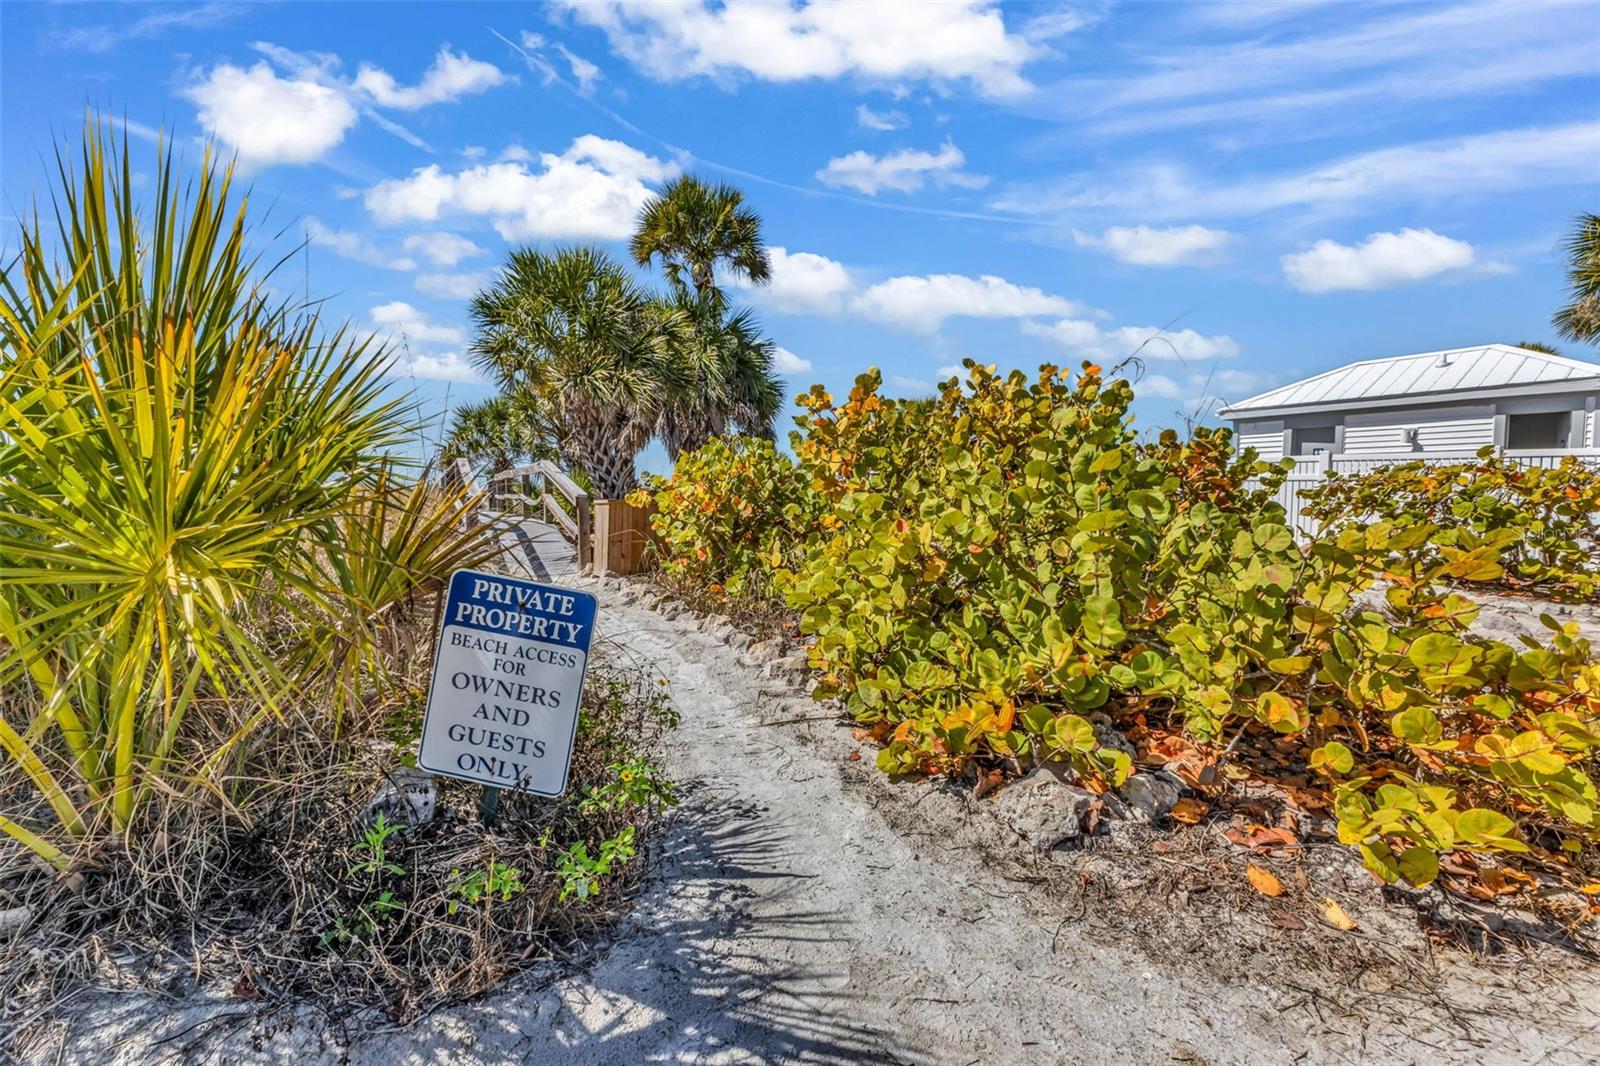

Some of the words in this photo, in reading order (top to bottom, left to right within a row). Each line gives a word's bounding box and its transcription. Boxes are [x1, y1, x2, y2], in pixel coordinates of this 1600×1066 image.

[472, 579, 575, 616] PRIVATE
[454, 602, 583, 643] PROPERTY
[451, 632, 508, 655] BEACH
[513, 645, 577, 668] ACCESS
[493, 659, 526, 677] FOR
[452, 672, 561, 708] OWNERS
[472, 704, 530, 727] AND
[448, 724, 546, 758] GUESTS
[457, 753, 528, 781] ONLY
